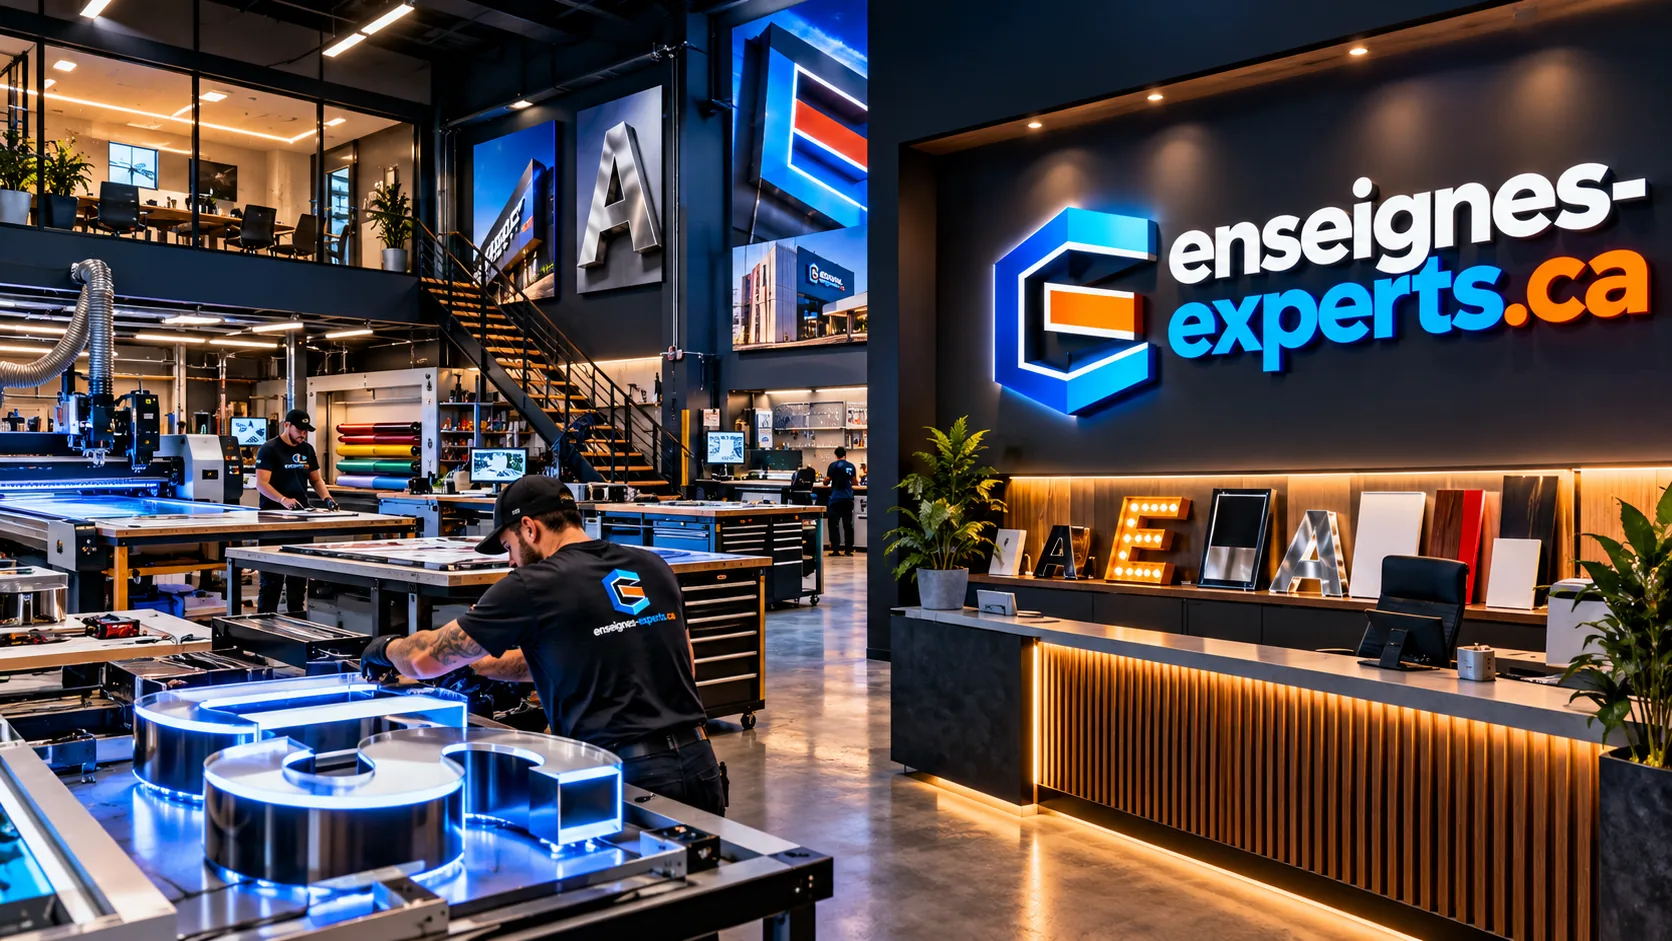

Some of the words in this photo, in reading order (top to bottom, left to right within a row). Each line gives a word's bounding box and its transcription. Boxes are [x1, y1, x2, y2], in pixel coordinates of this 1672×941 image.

[578, 121, 662, 269] A
[1168, 161, 1648, 286] enseignes-
[1167, 248, 1651, 373] experts.ca
[1105, 496, 1191, 585] E
[1269, 509, 1347, 598] A
